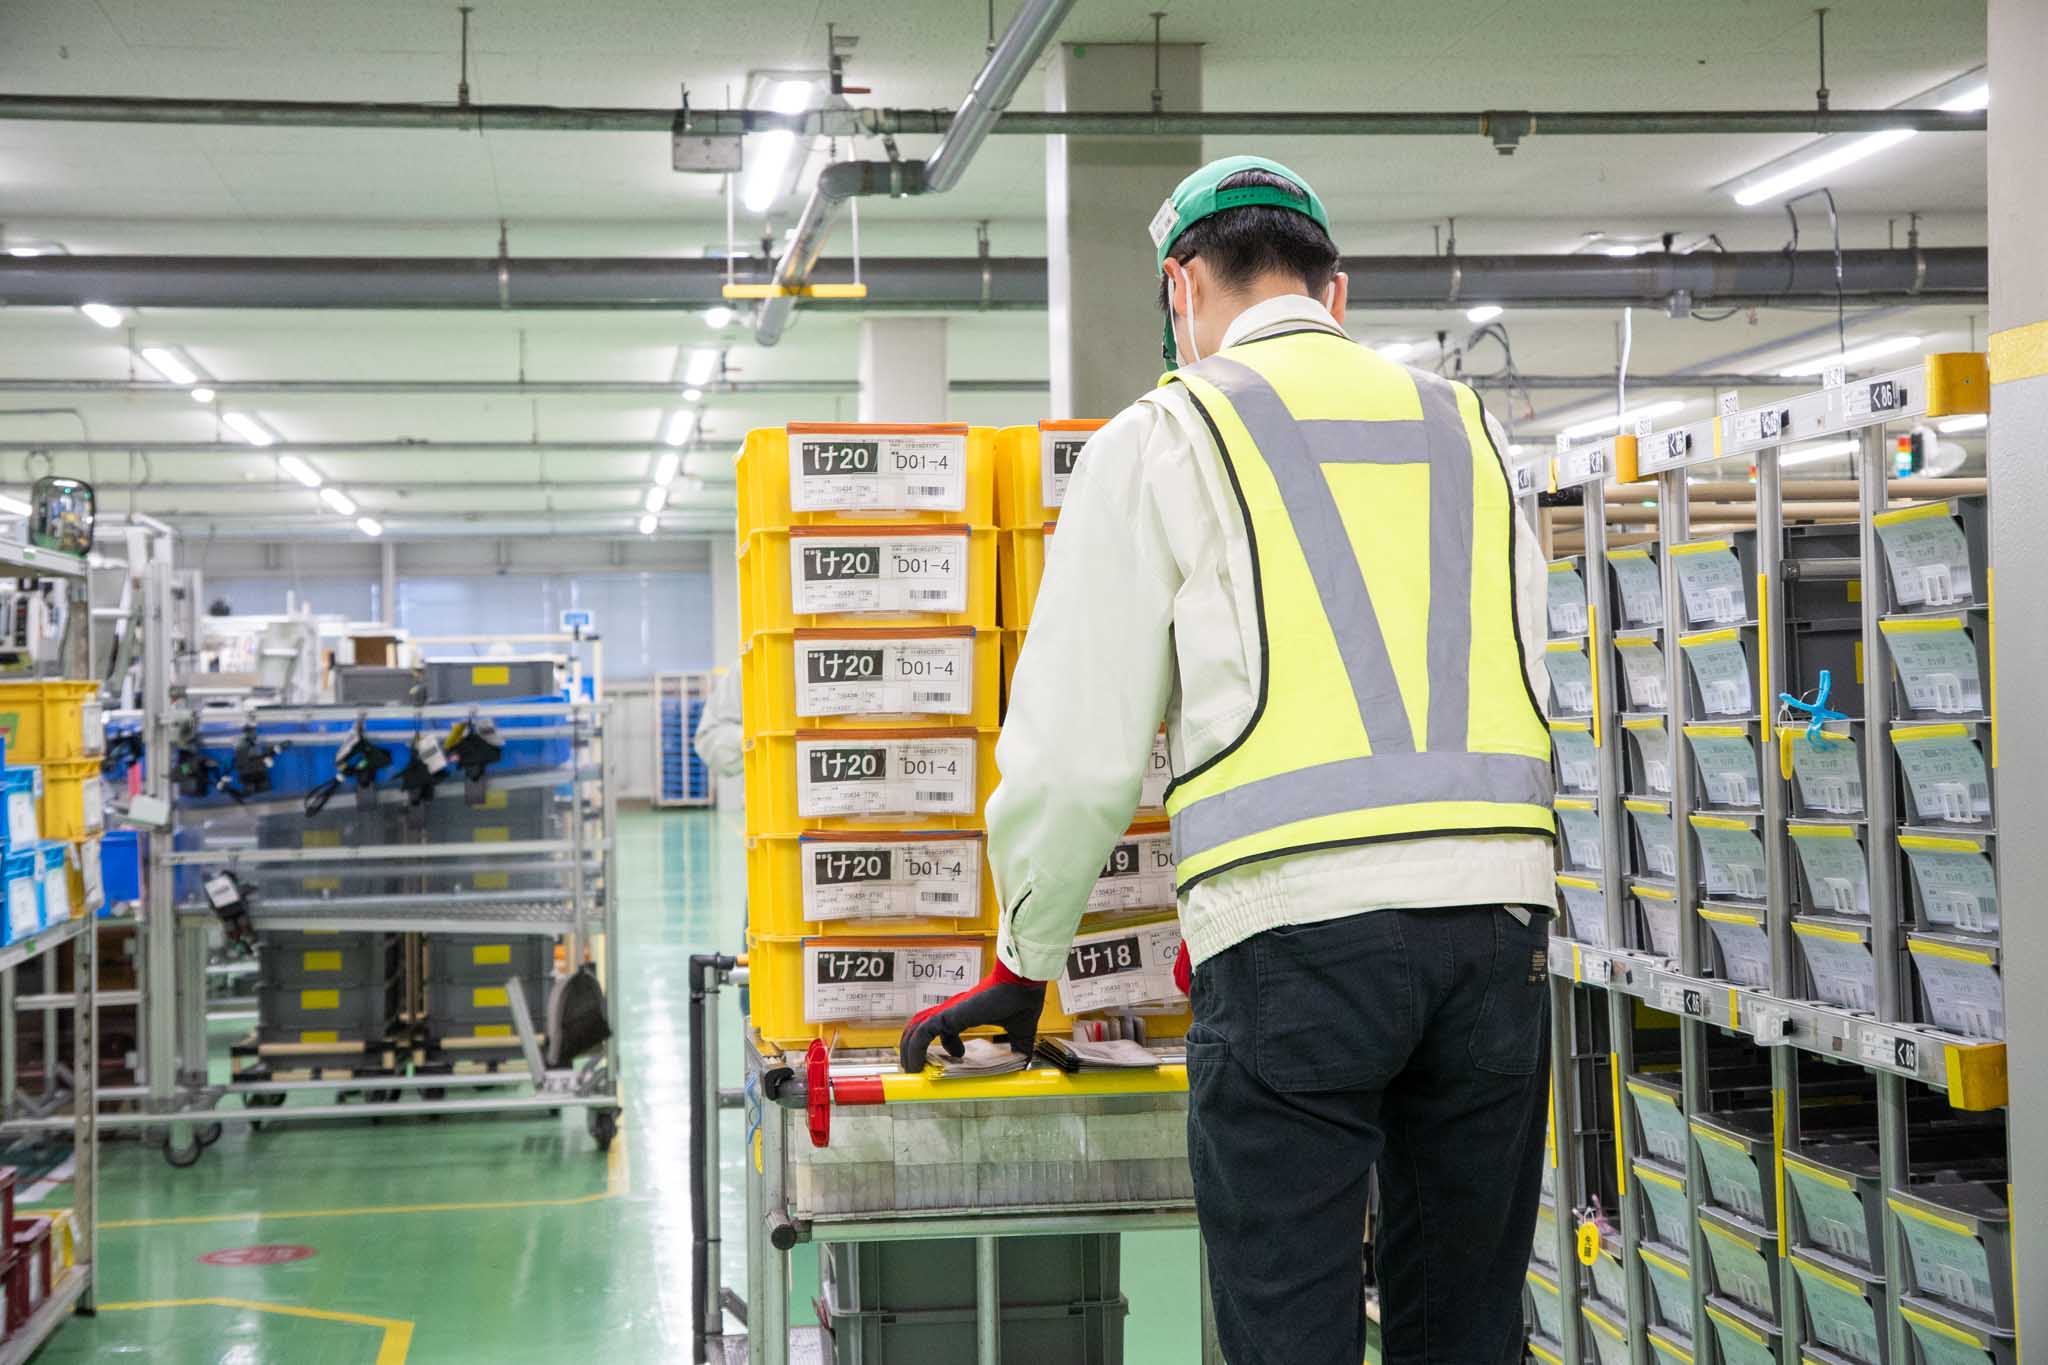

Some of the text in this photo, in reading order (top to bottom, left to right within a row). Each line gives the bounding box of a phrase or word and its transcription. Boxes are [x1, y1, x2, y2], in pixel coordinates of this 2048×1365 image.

[814, 444, 868, 471] け20
[896, 455, 948, 469] D01-4
[815, 550, 871, 576] け20
[898, 559, 950, 573] D01-4
[819, 653, 874, 679] け20
[901, 661, 954, 676] D01-4
[821, 753, 876, 779] け20
[904, 760, 957, 775] D01-4
[826, 854, 882, 880] け20
[909, 861, 962, 876] D01-4
[829, 953, 885, 980] け20
[912, 964, 965, 980] D01-4
[1076, 944, 1131, 974] け18
